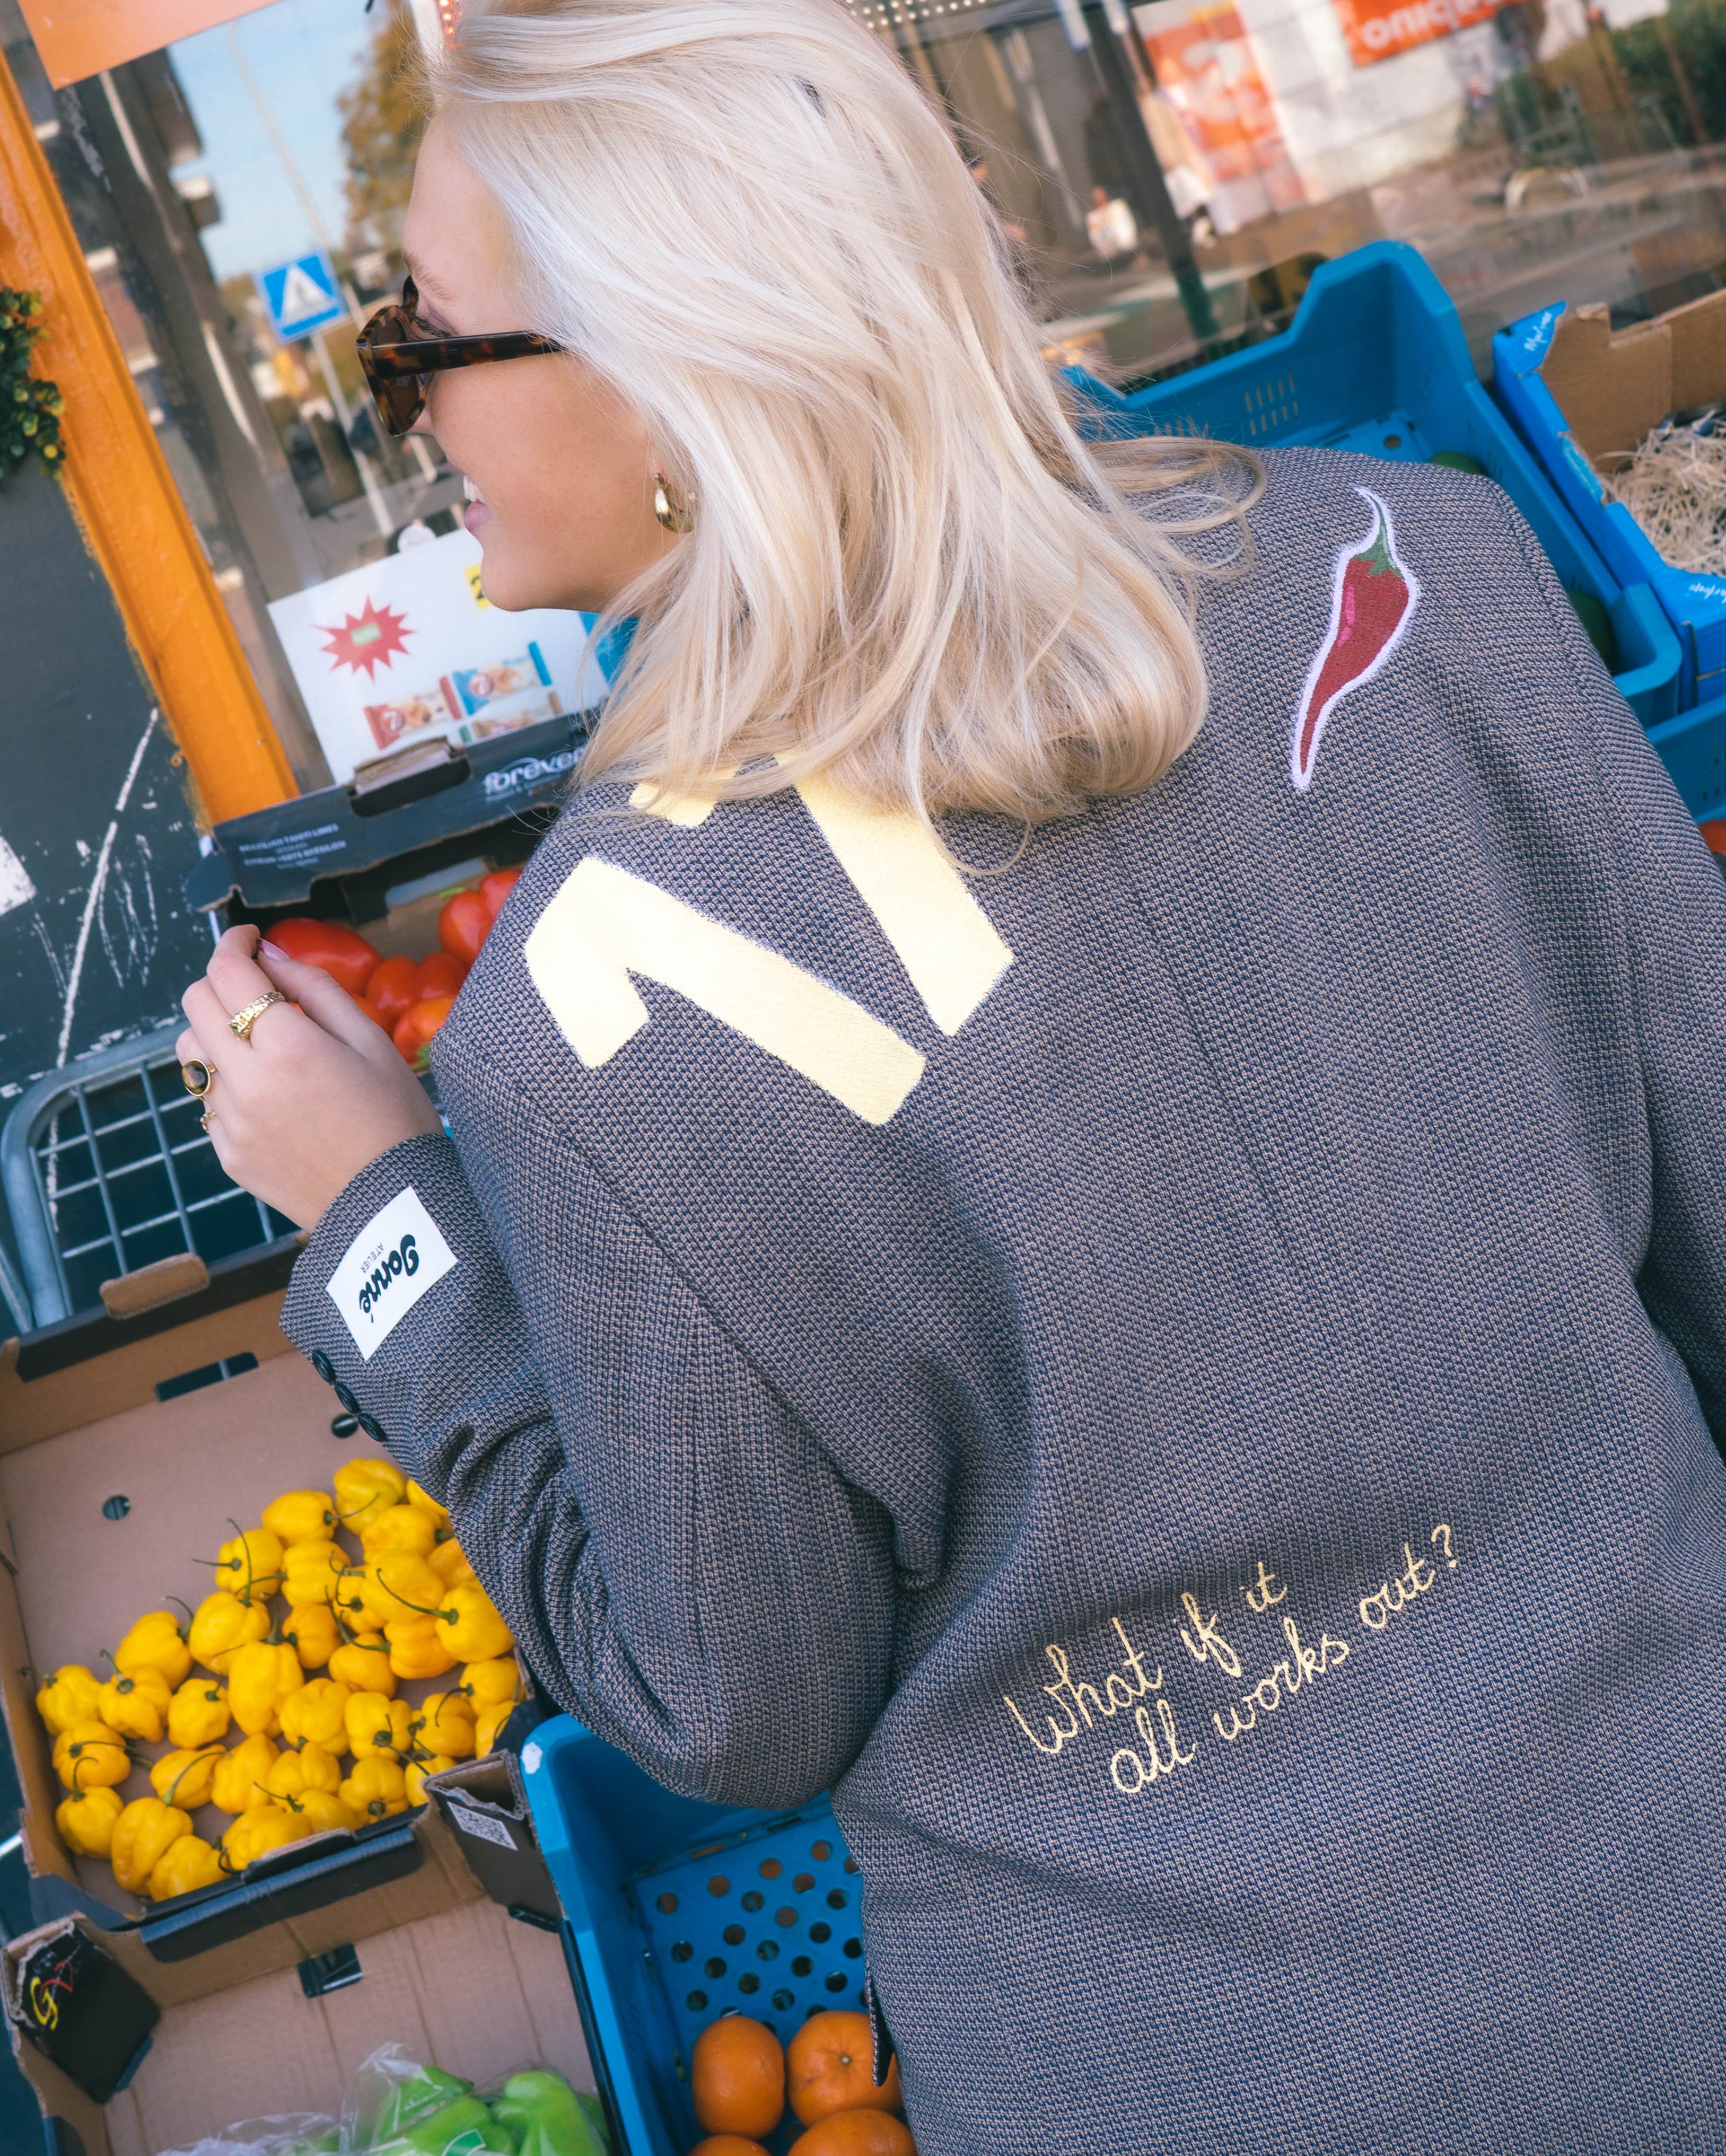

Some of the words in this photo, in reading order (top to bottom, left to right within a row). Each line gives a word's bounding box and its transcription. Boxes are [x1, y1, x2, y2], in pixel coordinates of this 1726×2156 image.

[360, 1241, 384, 1274] ATELIER
[1003, 1616, 1163, 1754] What
[1172, 1592, 1242, 1677] if
[1238, 1561, 1288, 1612] it
[1109, 1698, 1197, 1793] all
[1213, 1617, 1351, 1741] works
